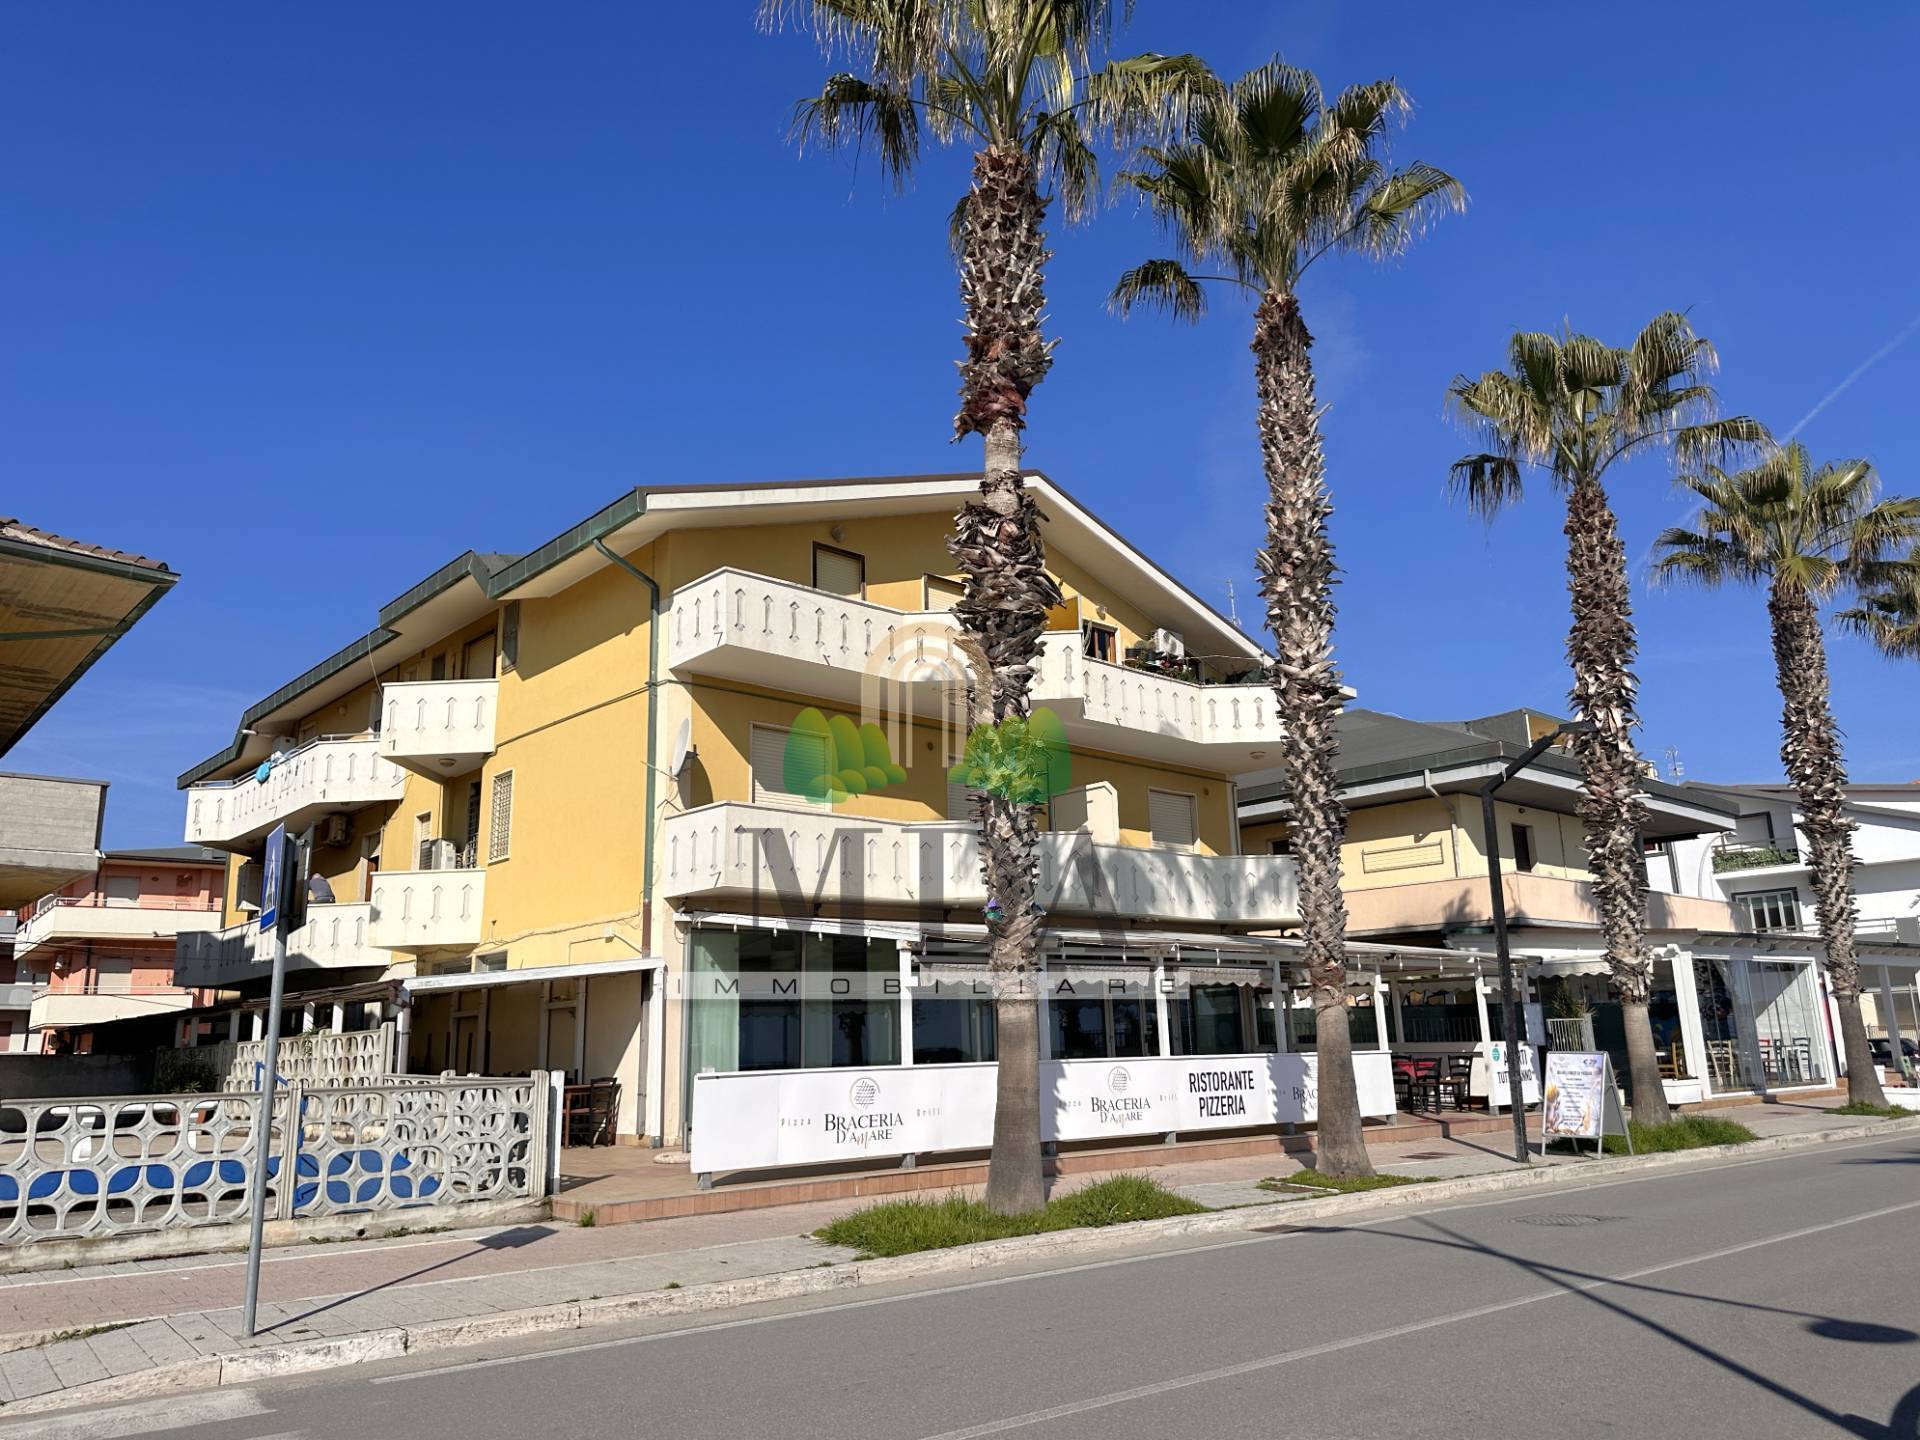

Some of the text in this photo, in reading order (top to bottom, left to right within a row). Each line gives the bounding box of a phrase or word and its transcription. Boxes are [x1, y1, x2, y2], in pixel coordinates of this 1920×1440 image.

[1189, 1070, 1255, 1093] RISTORANTE
[1091, 1096, 1152, 1113] BRACERIA
[1199, 1095, 1246, 1117] PIZZERIA
[824, 1112, 904, 1131] BRACERIA
